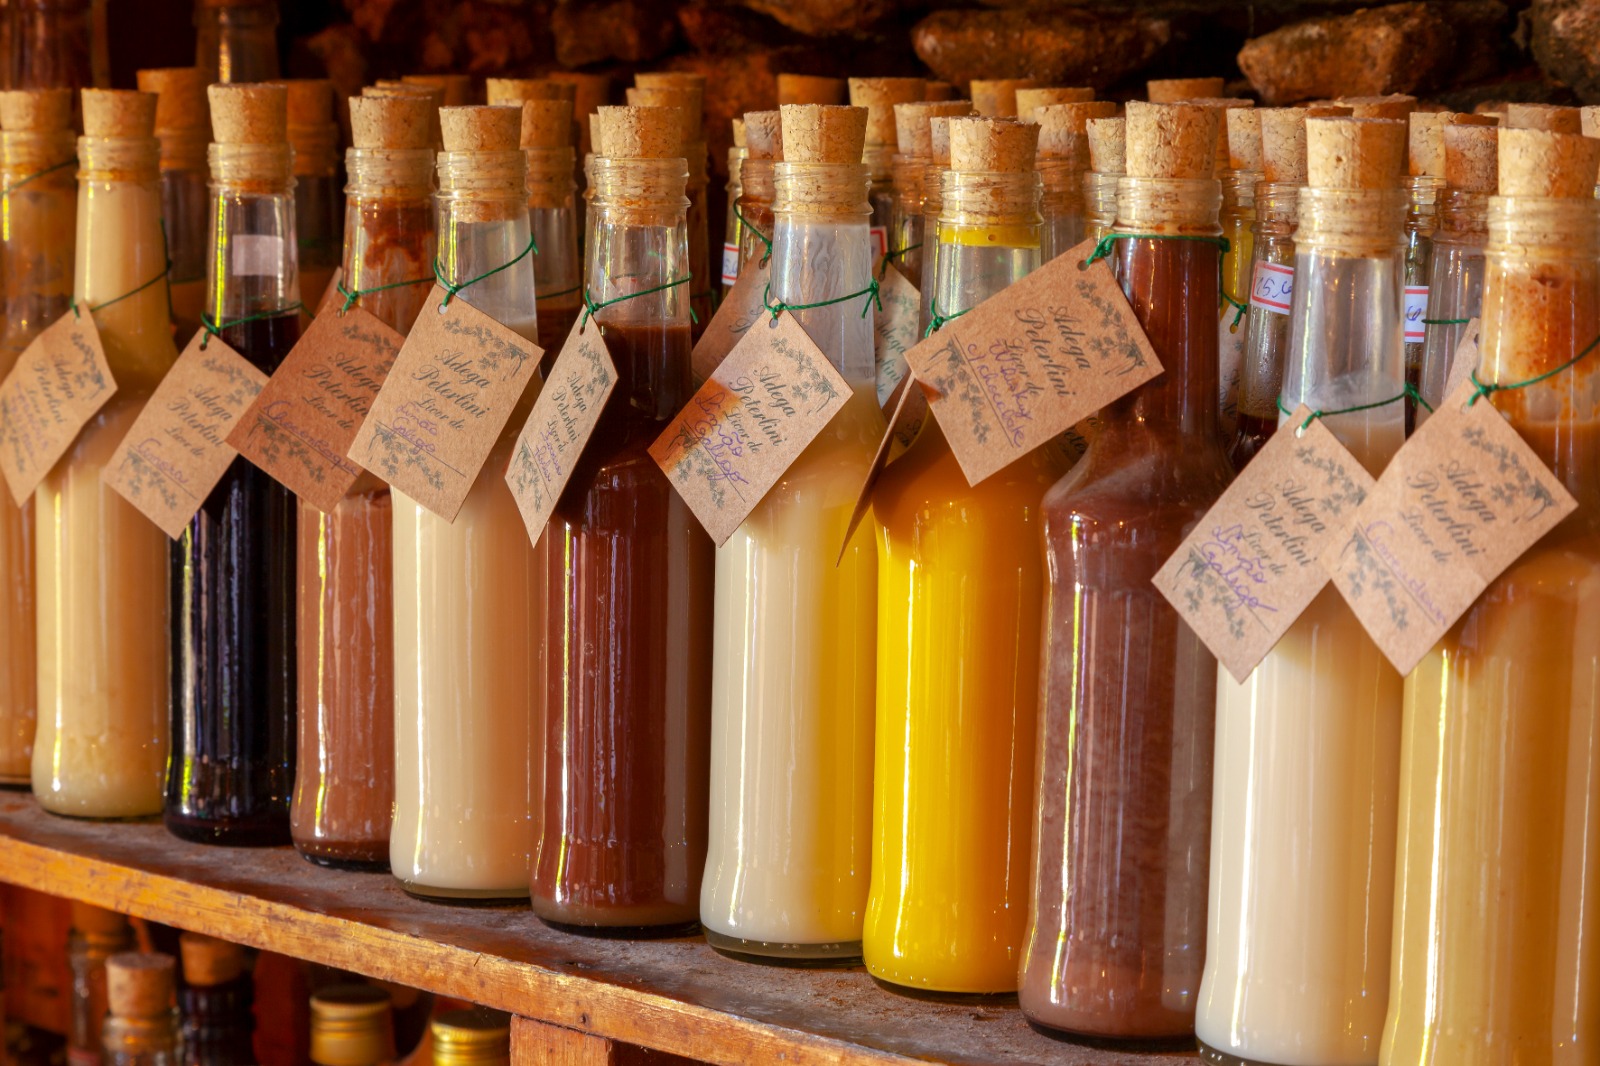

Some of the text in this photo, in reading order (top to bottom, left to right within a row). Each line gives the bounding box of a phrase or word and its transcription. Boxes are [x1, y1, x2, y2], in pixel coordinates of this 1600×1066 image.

[878, 321, 906, 354] dega
[1014, 307, 1077, 398] Peterlini
[1047, 304, 1092, 370] Adega
[52, 352, 75, 400] Adega
[302, 363, 370, 419] Peterlin
[326, 351, 382, 395] Adega
[411, 363, 491, 419] Peterlini
[434, 348, 491, 390] Adega
[566, 371, 587, 415] Adega
[753, 365, 797, 419] Adega
[1002, 336, 1045, 398] Licor de
[166, 395, 226, 448] Peterlini
[188, 382, 233, 422] Adega
[301, 391, 355, 431] Licor de
[414, 393, 465, 431] Licor de
[546, 414, 561, 445] Licor
[551, 384, 580, 444] Peterlini
[694, 391, 744, 458] Limão
[728, 375, 788, 448] Peterlini
[723, 406, 764, 454] Licor de
[1274, 479, 1327, 535] Adega
[1406, 469, 1487, 559] Peterlini
[1437, 459, 1498, 524] Adega
[1241, 524, 1289, 578] Licor de
[1245, 491, 1318, 568] Peterlini
[1397, 505, 1453, 565] Licor de
